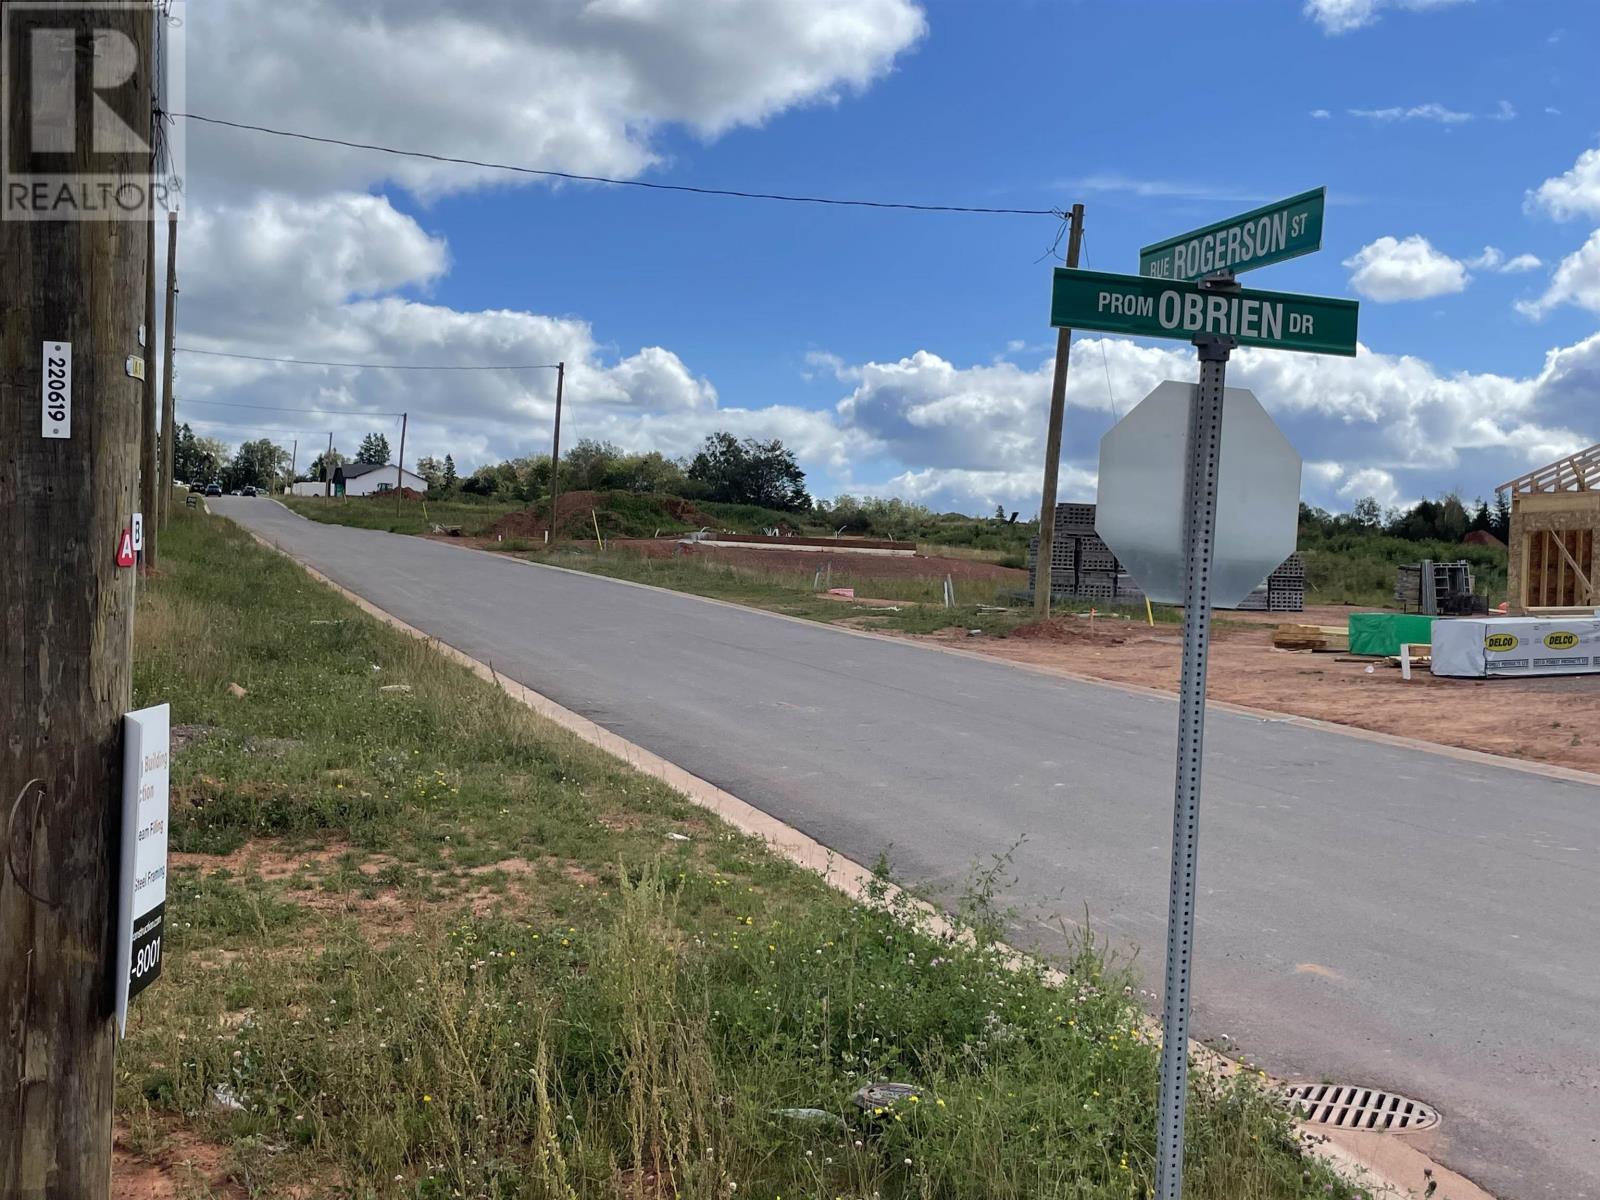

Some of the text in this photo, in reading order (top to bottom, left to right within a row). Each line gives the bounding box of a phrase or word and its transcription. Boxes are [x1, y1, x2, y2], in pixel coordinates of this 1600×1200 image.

[1150, 211, 1307, 280] RUE ROGERSON ST
[1098, 290, 1313, 340] PROM OBRIEN DR
[47, 357, 66, 422] 220619
[121, 534, 132, 558] A
[1488, 637, 1513, 647] DELCO
[1549, 635, 1573, 645] DELCO
[144, 752, 167, 772] Building
[130, 936, 160, 982] -8001
